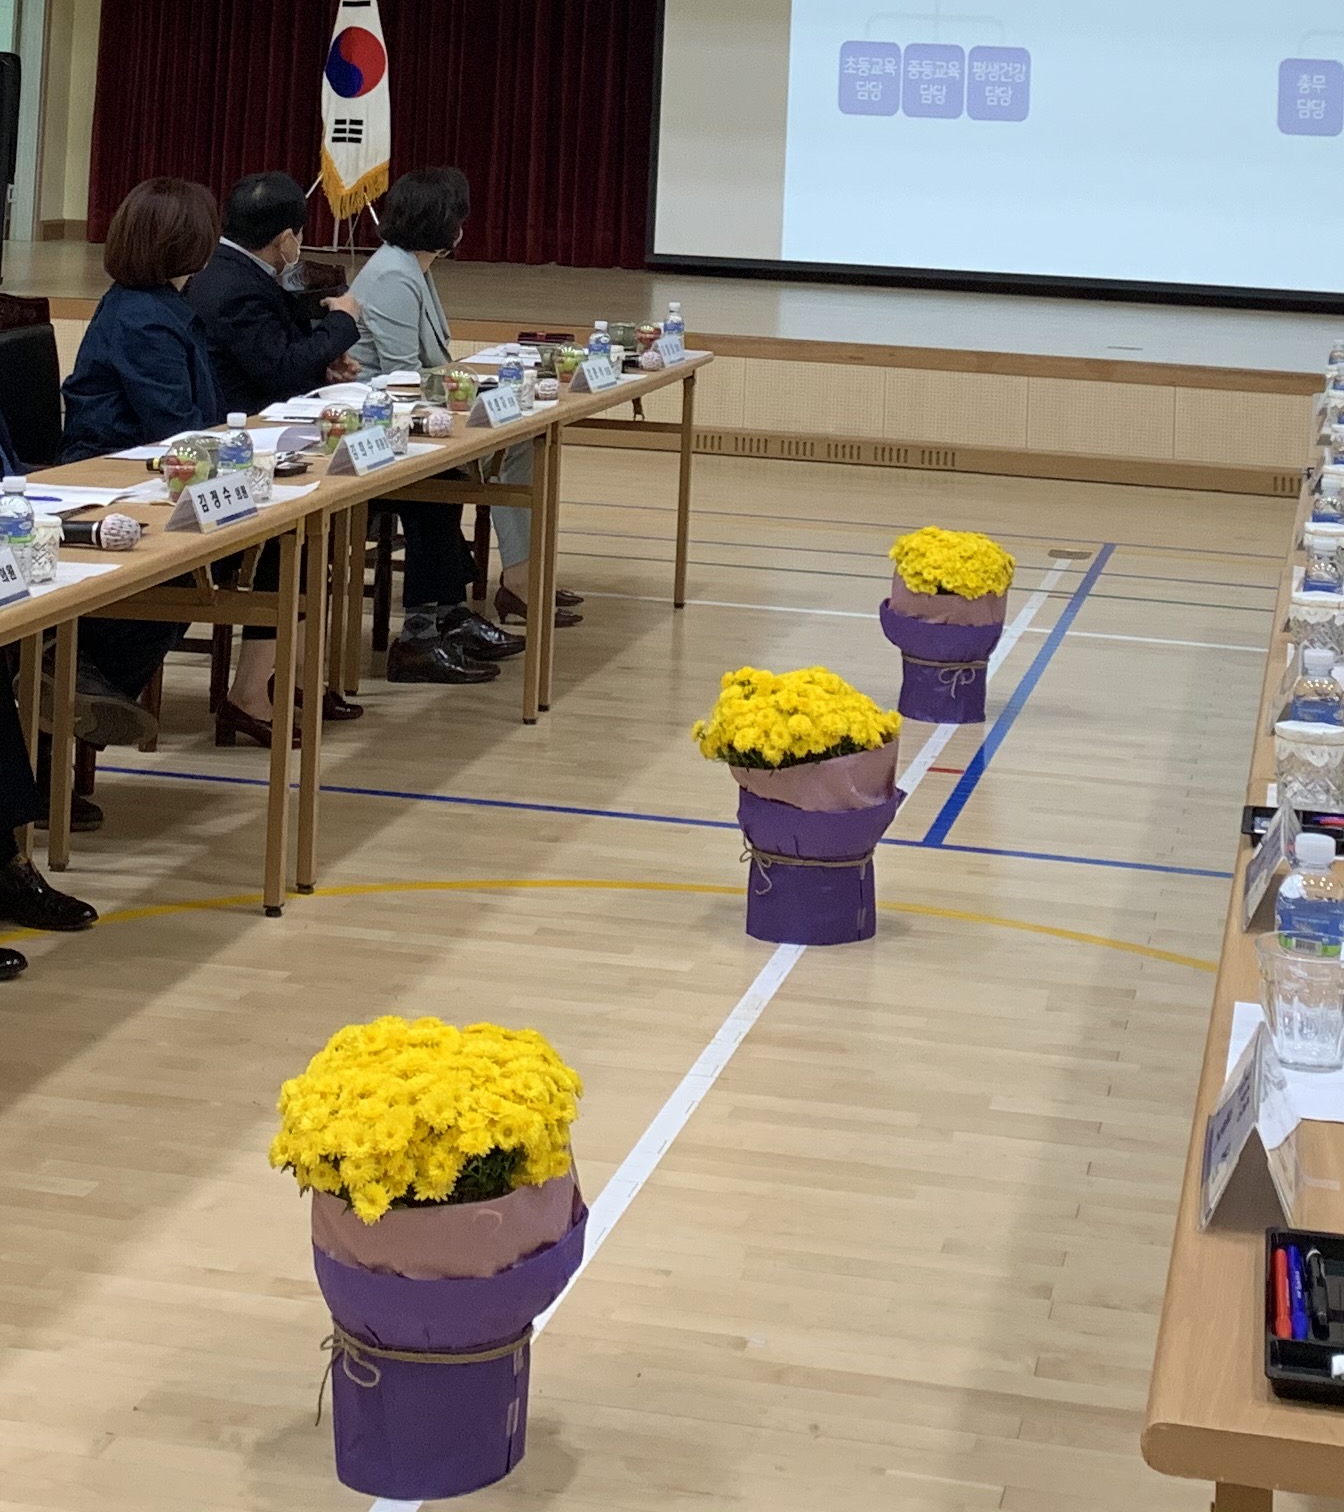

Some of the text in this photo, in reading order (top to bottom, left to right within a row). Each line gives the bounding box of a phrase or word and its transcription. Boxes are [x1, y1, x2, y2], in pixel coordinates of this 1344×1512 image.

[844, 56, 897, 77] 초등교육
[907, 59, 960, 80] 중등교육
[973, 61, 1027, 82] 평생건강
[856, 81, 883, 101] 담당
[920, 84, 947, 104] 담당
[985, 86, 1013, 106] 담당
[1297, 99, 1327, 120] 담당
